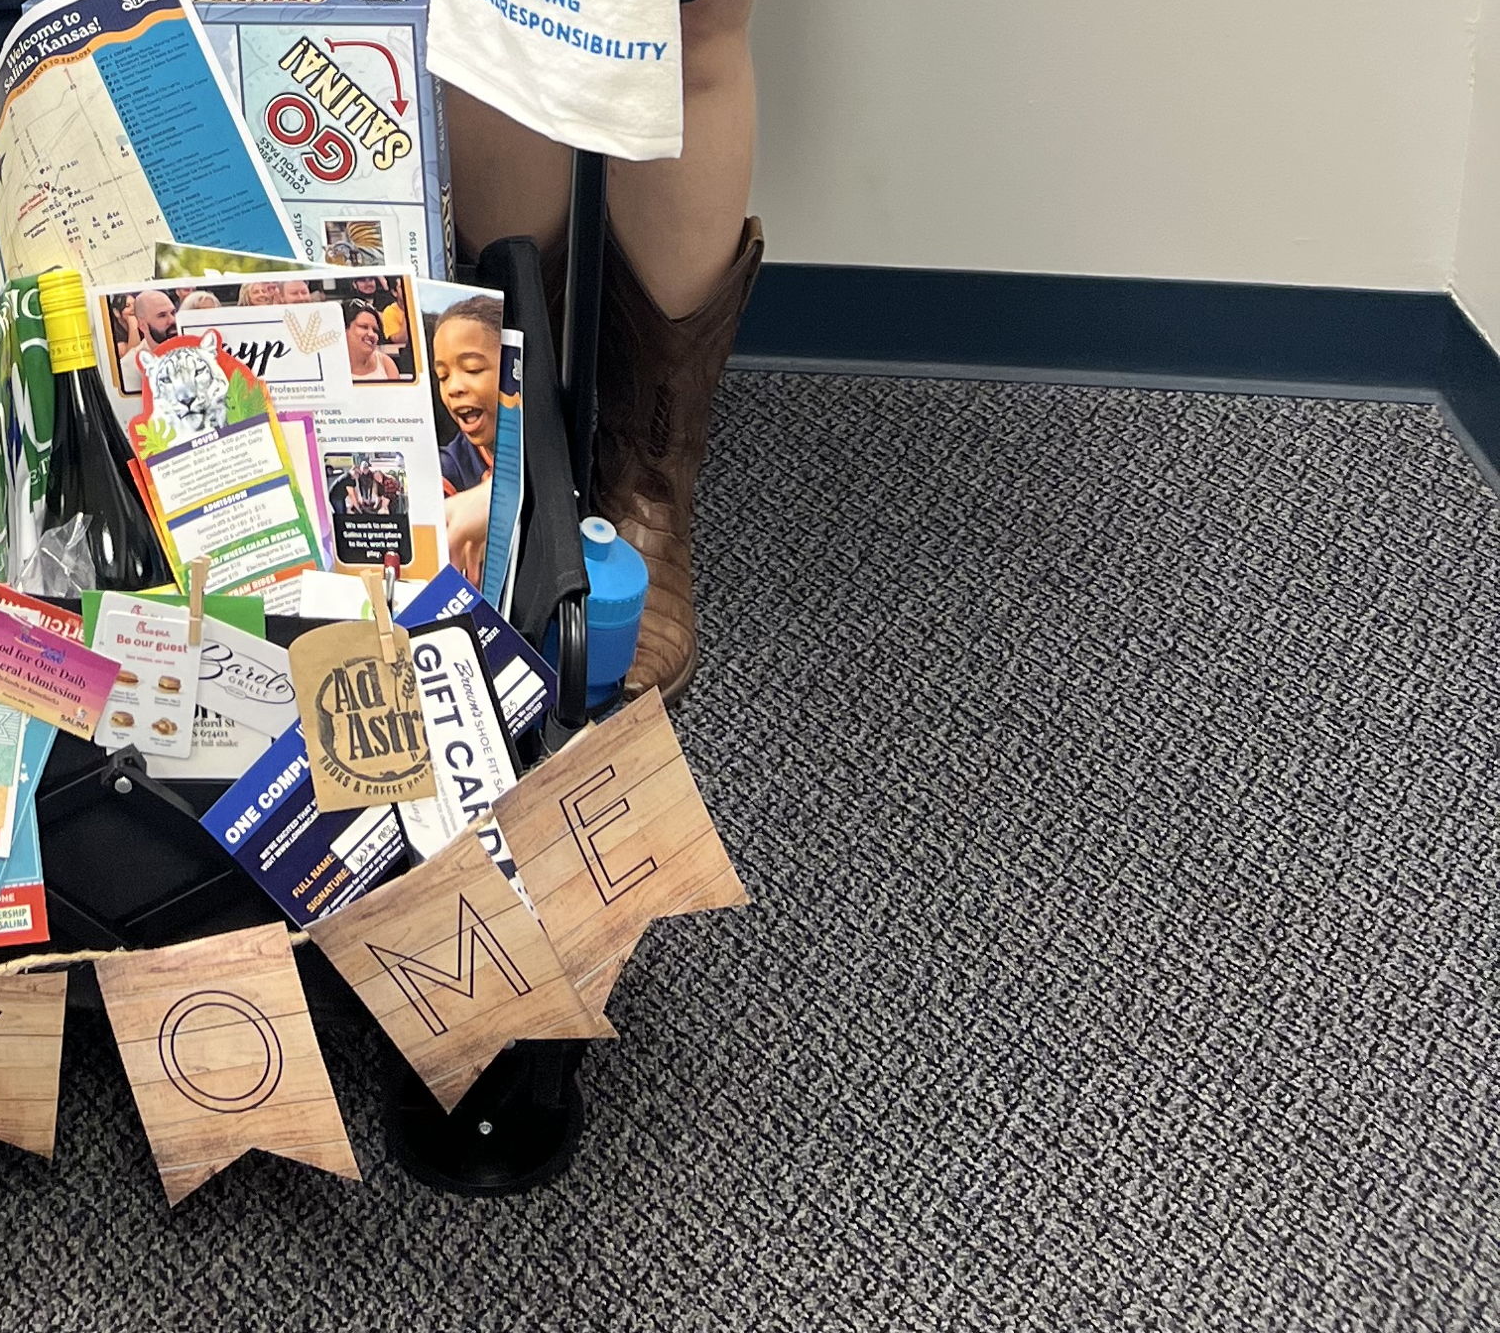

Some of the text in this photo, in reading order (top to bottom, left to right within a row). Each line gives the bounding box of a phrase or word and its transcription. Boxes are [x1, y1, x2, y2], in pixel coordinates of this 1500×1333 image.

[4, 52, 38, 94] Salina,
[38, 17, 102, 58] Kansas!
[6, 12, 81, 69] Welcome to
[49, 58, 59, 66] TO
[278, 35, 412, 170] SALINA!
[265, 92, 357, 183] GO
[260, 136, 310, 186] AS YOU PASS
[272, 161, 304, 195] COLLECT
[190, 432, 219, 447] HOURS
[201, 490, 248, 512] ADMISSION
[256, 519, 272, 528] FREE
[269, 527, 301, 541] RENTAL
[251, 574, 276, 587] RIDES
[116, 634, 188, 653] Be our guest
[13, 649, 33, 664] for
[33, 657, 58, 674] One
[58, 668, 89, 688] Daily
[22, 671, 84, 701] Admission
[228, 676, 269, 699] GRILLE
[332, 662, 385, 714] Ad
[412, 642, 465, 730] GIFT
[59, 715, 91, 731] SALINA
[224, 718, 235, 727] St
[454, 658, 499, 776] Brown's SHOE FIT
[200, 738, 239, 748] full shake
[348, 711, 430, 761] Astr
[225, 815, 257, 844] ONE
[258, 751, 310, 810] COMPL
[353, 784, 361, 794] &
[365, 782, 404, 796] COFFEE
[258, 805, 312, 860] WE'RE EXCITED THAT
[260, 854, 277, 871] VISIT
[292, 853, 338, 898] FULL NAME:
[306, 867, 352, 913] SIGNATURE:
